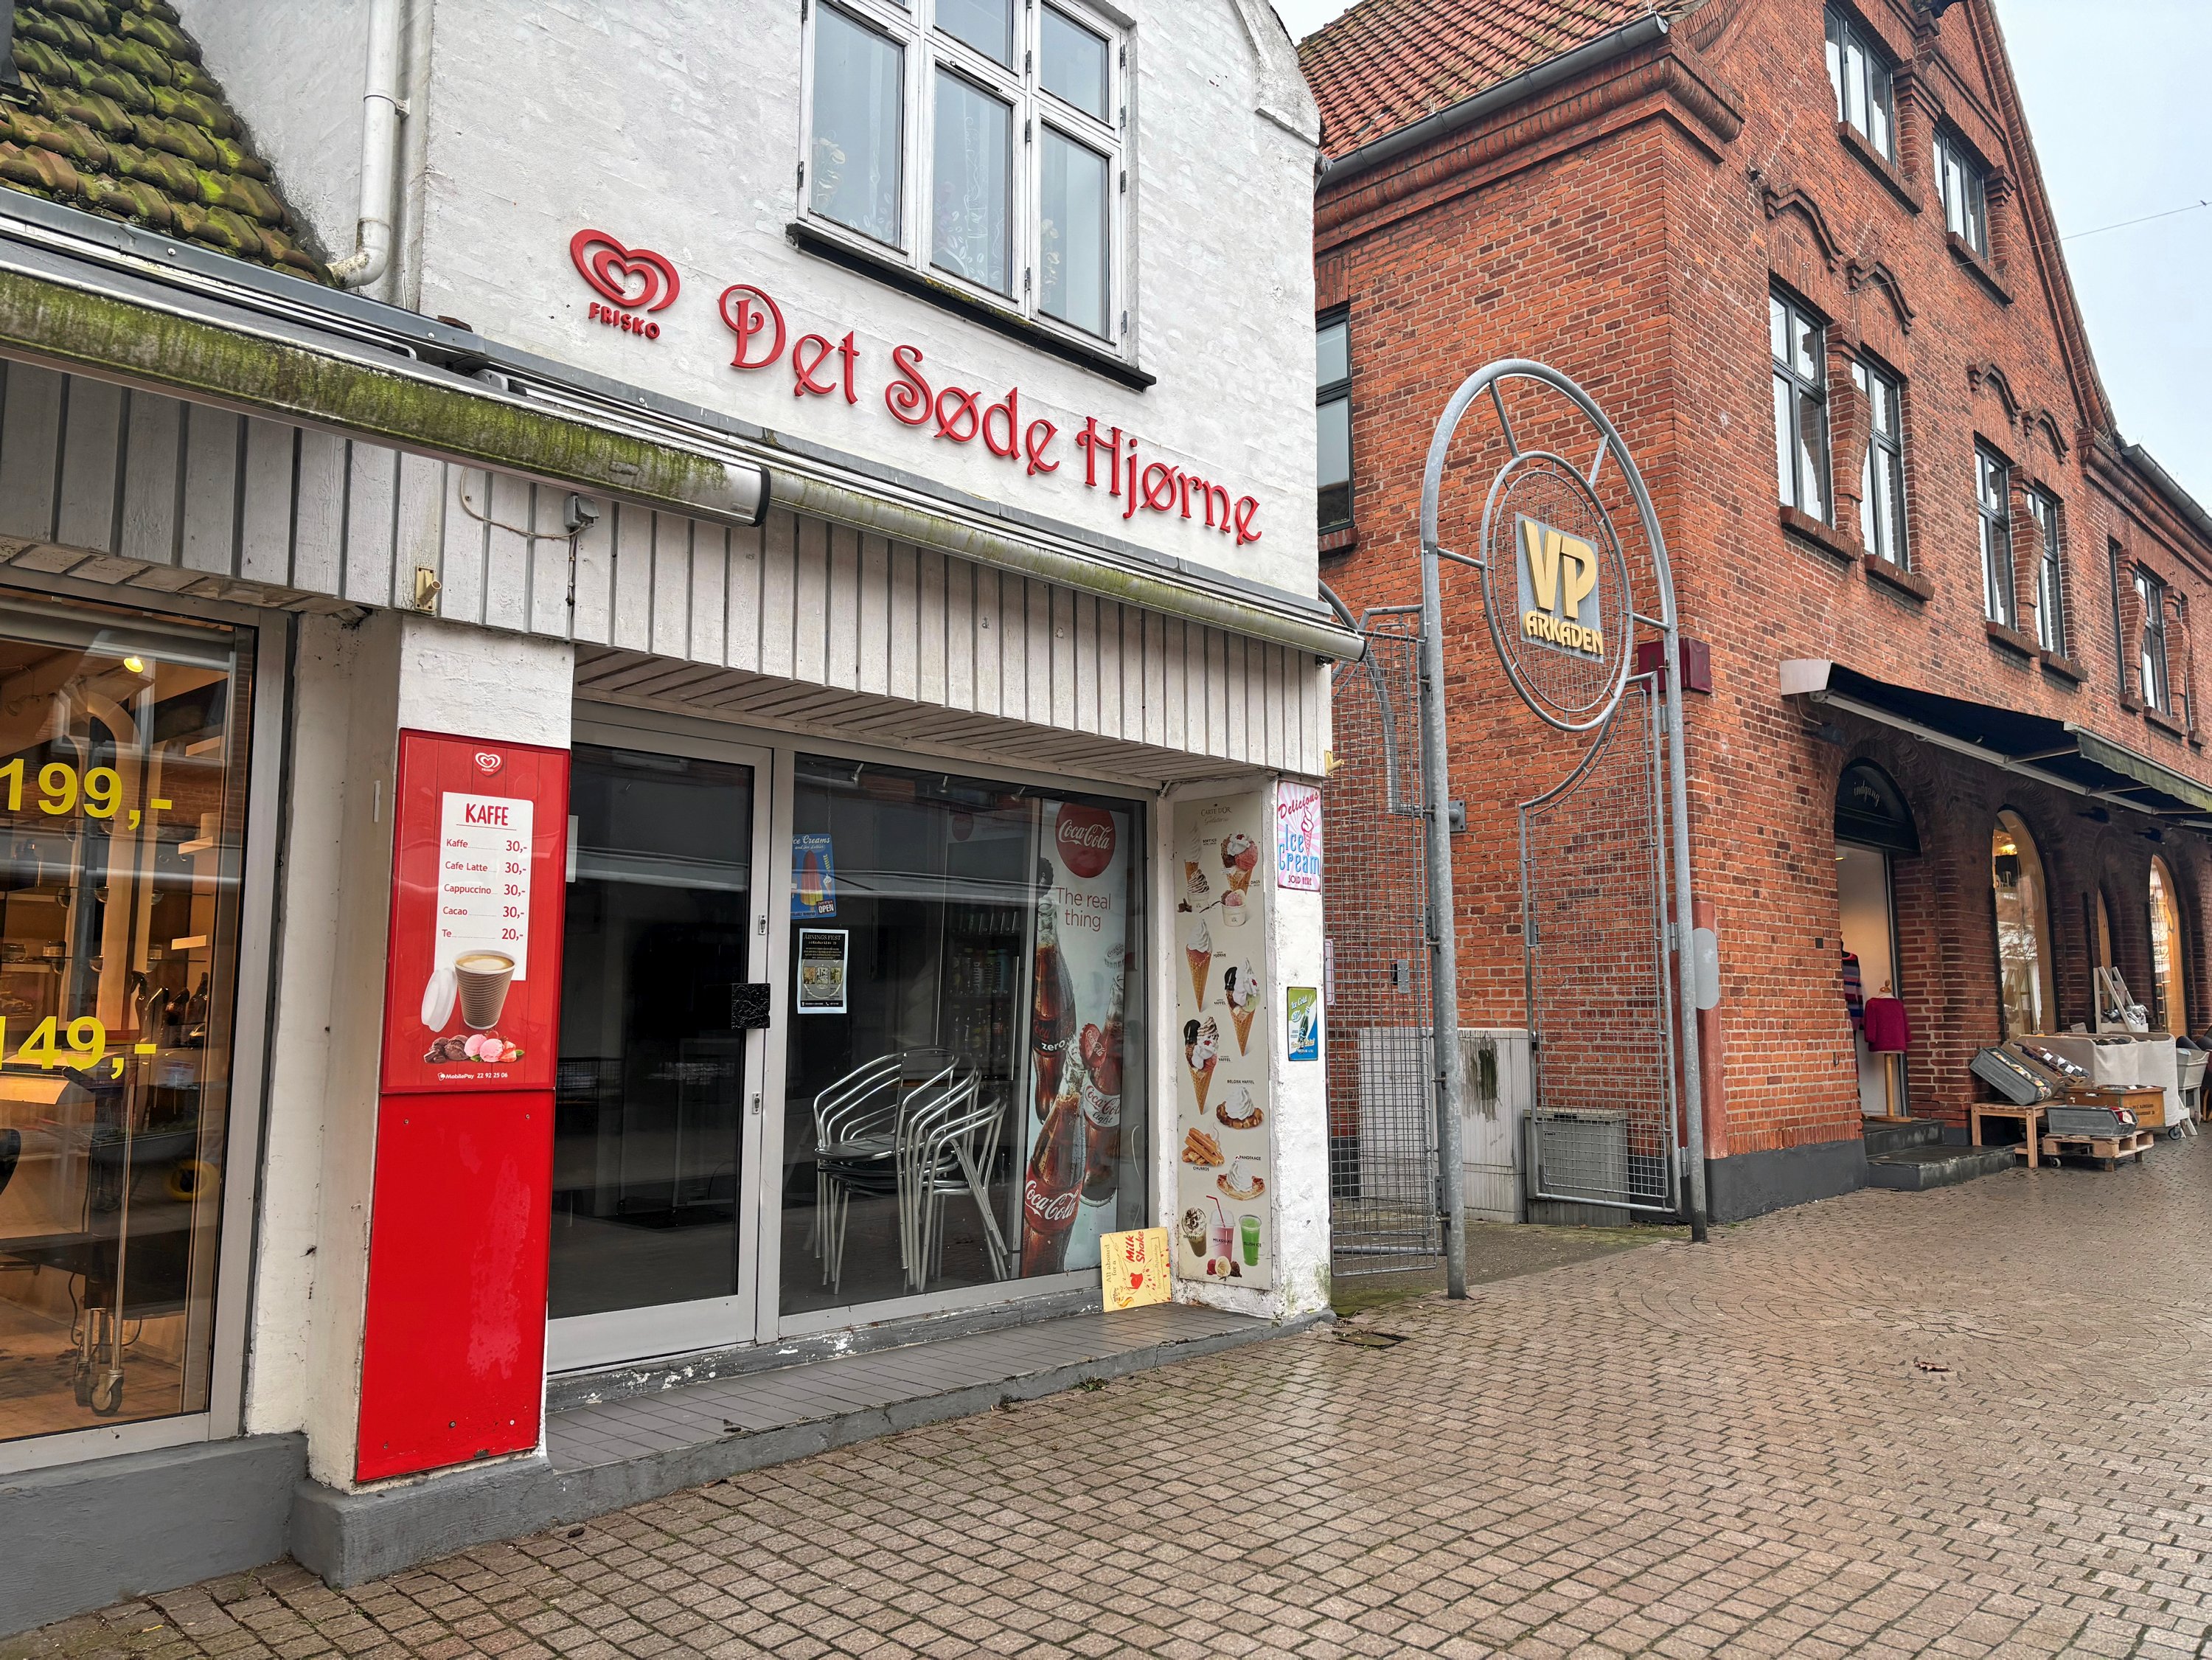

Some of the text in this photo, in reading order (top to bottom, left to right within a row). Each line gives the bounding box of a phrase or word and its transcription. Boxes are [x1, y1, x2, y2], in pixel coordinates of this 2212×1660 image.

[589, 302, 661, 340] FRISKO
[718, 284, 1262, 546] Det Søde Hjørne
[1522, 518, 1596, 620] VP
[1523, 609, 1604, 656] ARKADEN
[1277, 791, 1319, 819] Delicious
[1853, 779, 1881, 808] indgang
[465, 802, 509, 827] KAFFE
[1200, 808, 1217, 816] CARTE
[446, 838, 528, 853] Kaffe 30,-
[802, 835, 830, 844] Creams
[1058, 819, 1113, 850] Coca-Cola
[1285, 824, 1304, 853] Ice
[445, 861, 527, 875] Cafe Latte 30,-
[1278, 843, 1321, 876] Cream
[444, 883, 526, 897] Cappuccino 30,-
[1288, 875, 1301, 885] SOLD
[818, 904, 834, 914] OPEN
[1055, 886, 1112, 910] The real
[442, 906, 525, 920] Cacao 30,-
[1065, 908, 1102, 932] thing
[442, 928, 524, 941] Te 20,-
[1041, 1040, 1066, 1051] zero
[1085, 1085, 1121, 1116] Coca-Col
[1093, 1111, 1113, 1124] light
[1125, 1234, 1135, 1263] Milk
[1135, 1231, 1145, 1265] Shake
